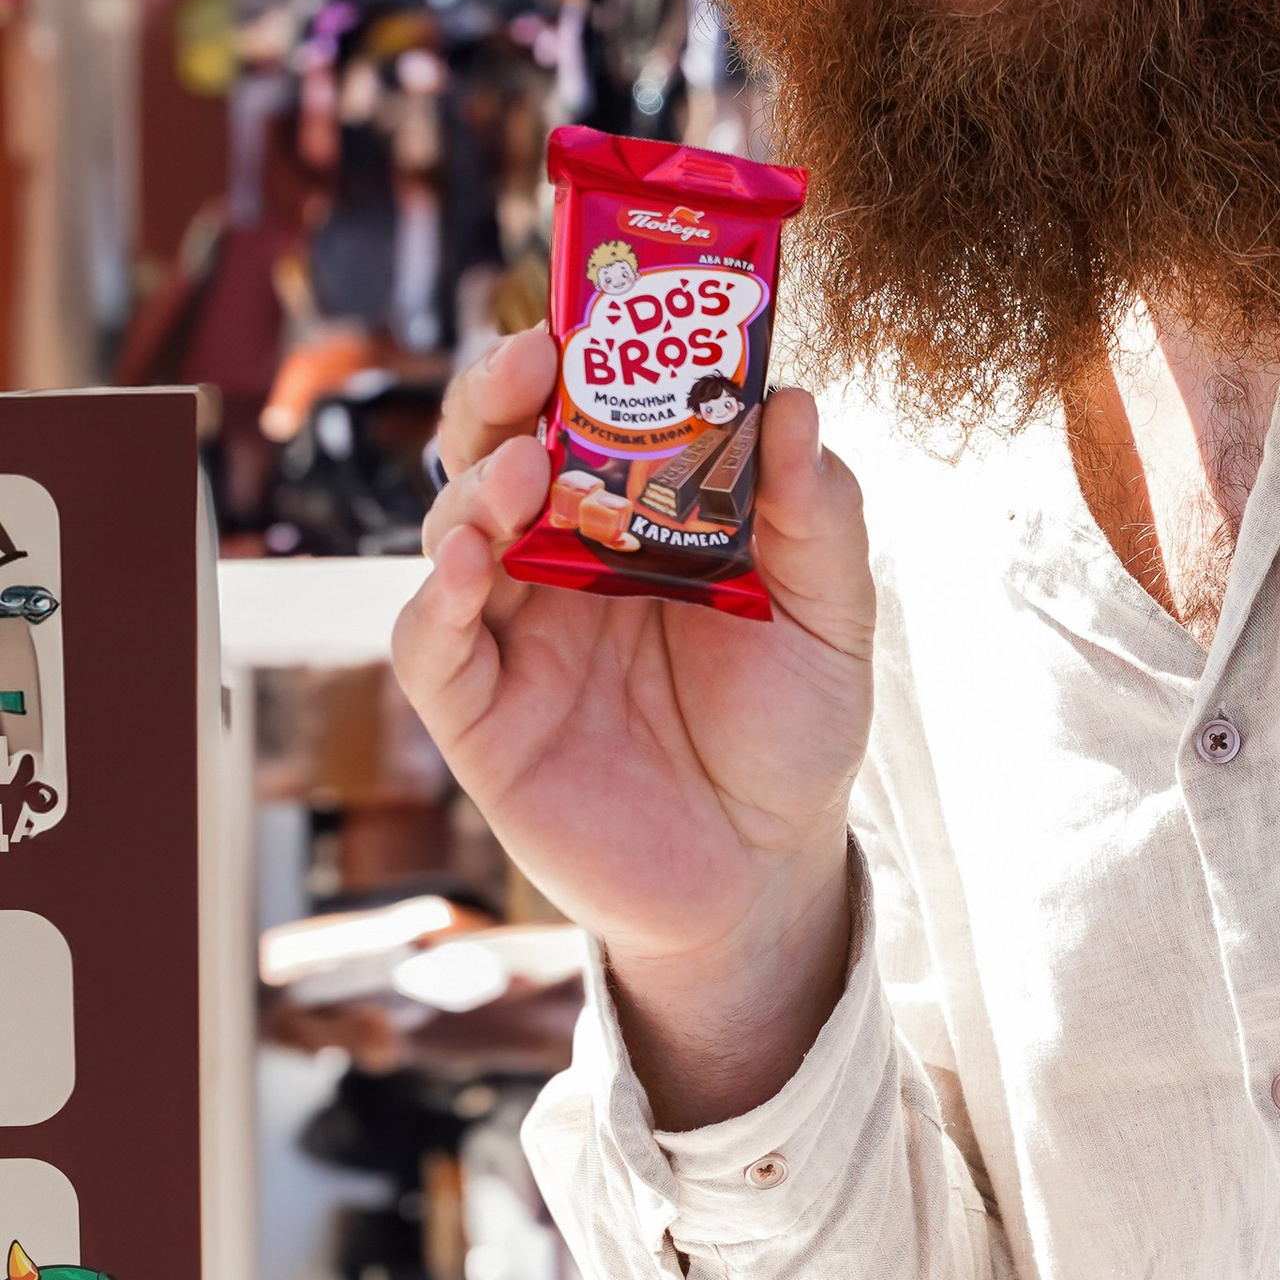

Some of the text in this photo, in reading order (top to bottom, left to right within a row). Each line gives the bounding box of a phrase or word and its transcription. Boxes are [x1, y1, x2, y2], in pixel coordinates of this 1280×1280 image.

[627, 209, 710, 242] Победа
[623, 279, 735, 335] DOS
[583, 328, 727, 385] BROS
[571, 411, 647, 446] ХРУСТЯЩИЕ
[651, 424, 694, 444] ВАФЛИ
[630, 516, 730, 547] КАРАМЕЛЬ
